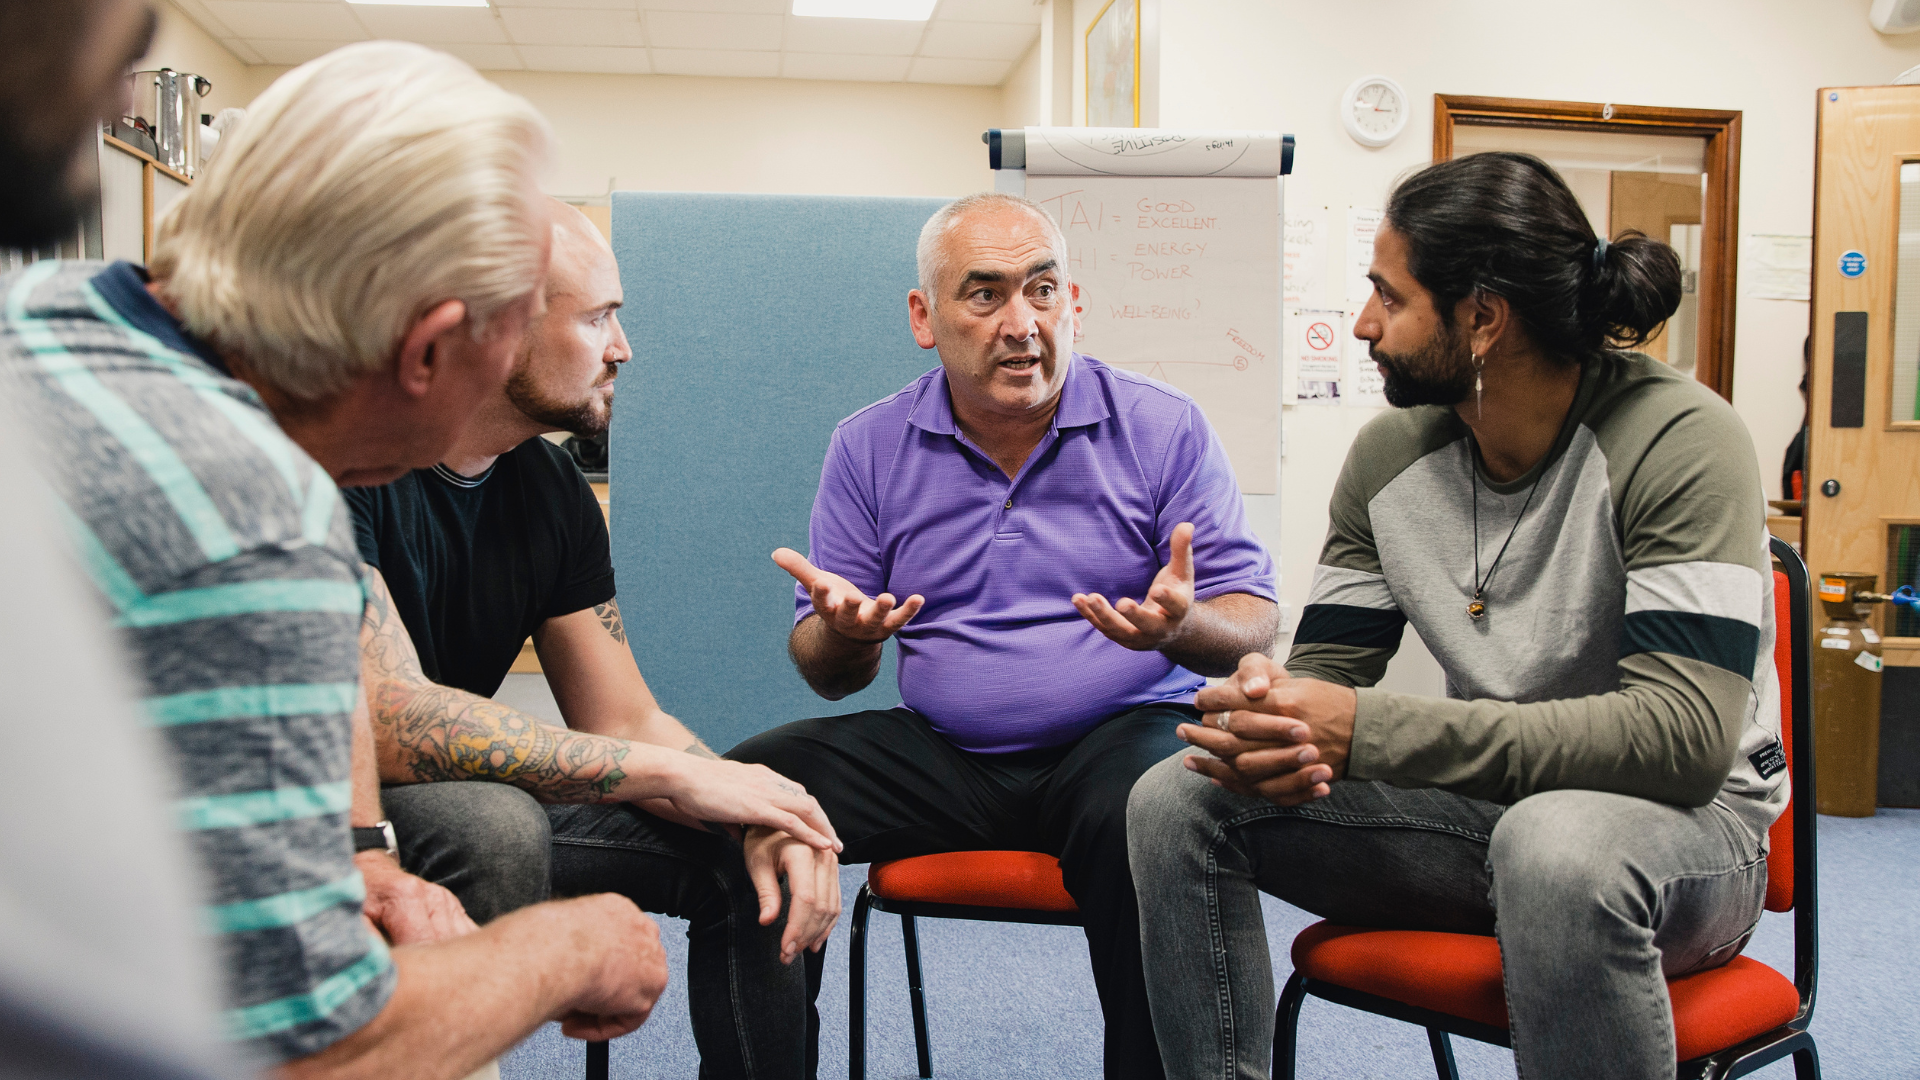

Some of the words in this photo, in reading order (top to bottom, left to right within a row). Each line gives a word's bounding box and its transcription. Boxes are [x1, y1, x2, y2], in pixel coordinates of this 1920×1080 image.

[1137, 198, 1195, 213] GOOD
[1068, 247, 1097, 271] HI
[1134, 242, 1208, 257] ENERGY
[1127, 262, 1193, 281] POWER
